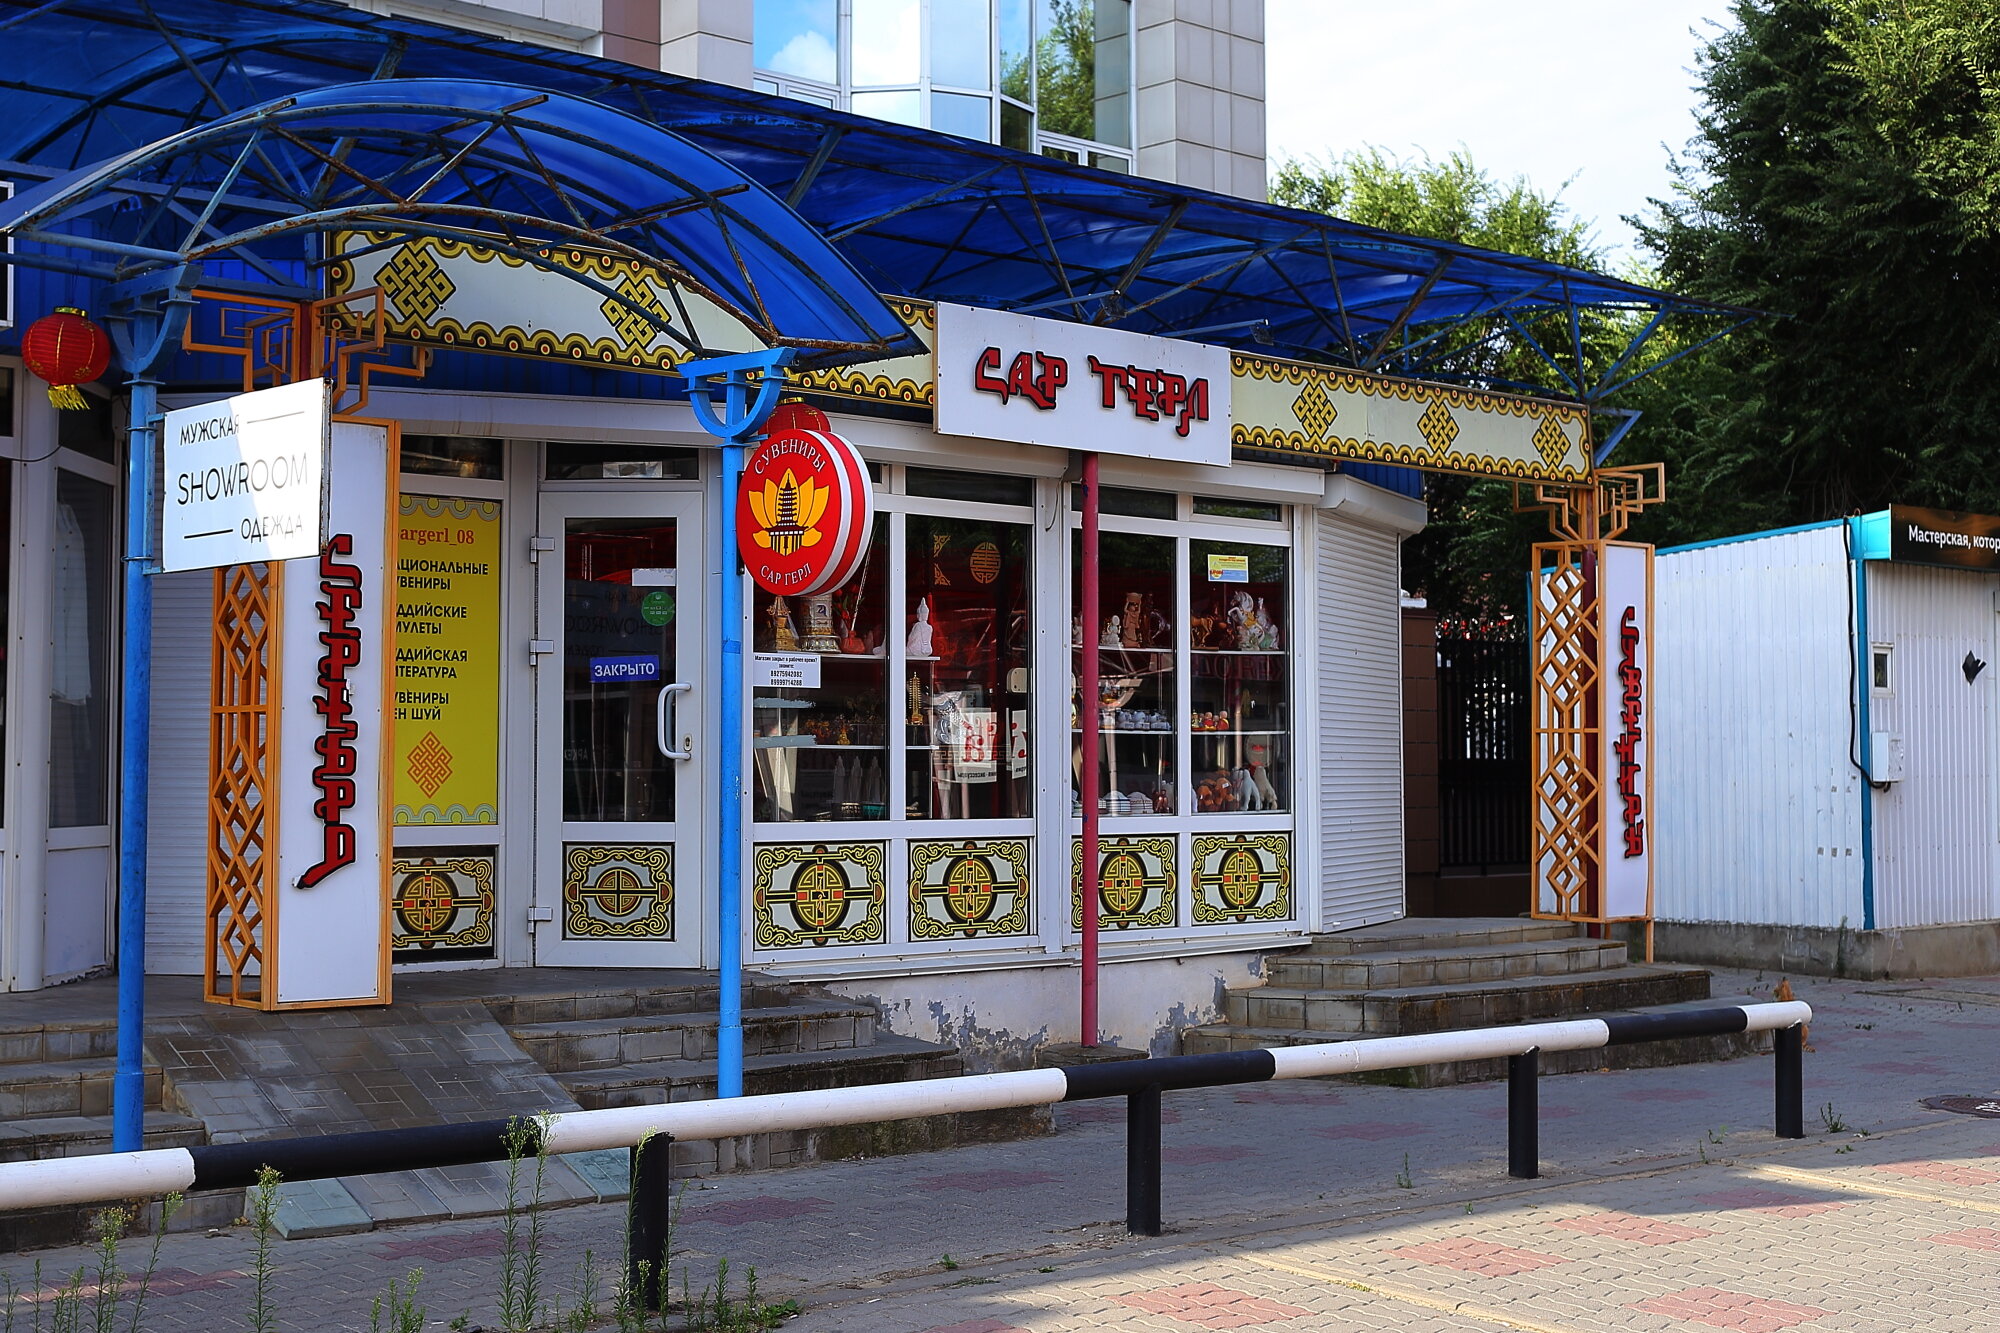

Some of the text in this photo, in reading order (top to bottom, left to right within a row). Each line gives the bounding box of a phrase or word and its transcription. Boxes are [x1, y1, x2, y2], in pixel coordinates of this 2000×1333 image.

[179, 414, 240, 446] МУЖСКАЯ
[754, 438, 827, 475] СУВЕНИРЫ
[176, 452, 308, 506] SHOWROOM
[240, 514, 304, 544] ОДЕЖДА
[398, 527, 475, 546] argerl_08
[1908, 524, 1972, 550] Мастерская,
[760, 561, 812, 586] САР ГЕРЛ
[396, 601, 467, 619] ДДИЙСКИЕ
[395, 645, 468, 662] ДДИЙСКАЯ
[594, 662, 656, 677] ЗАКРЫТО
[411, 705, 441, 720] ШУЙ
